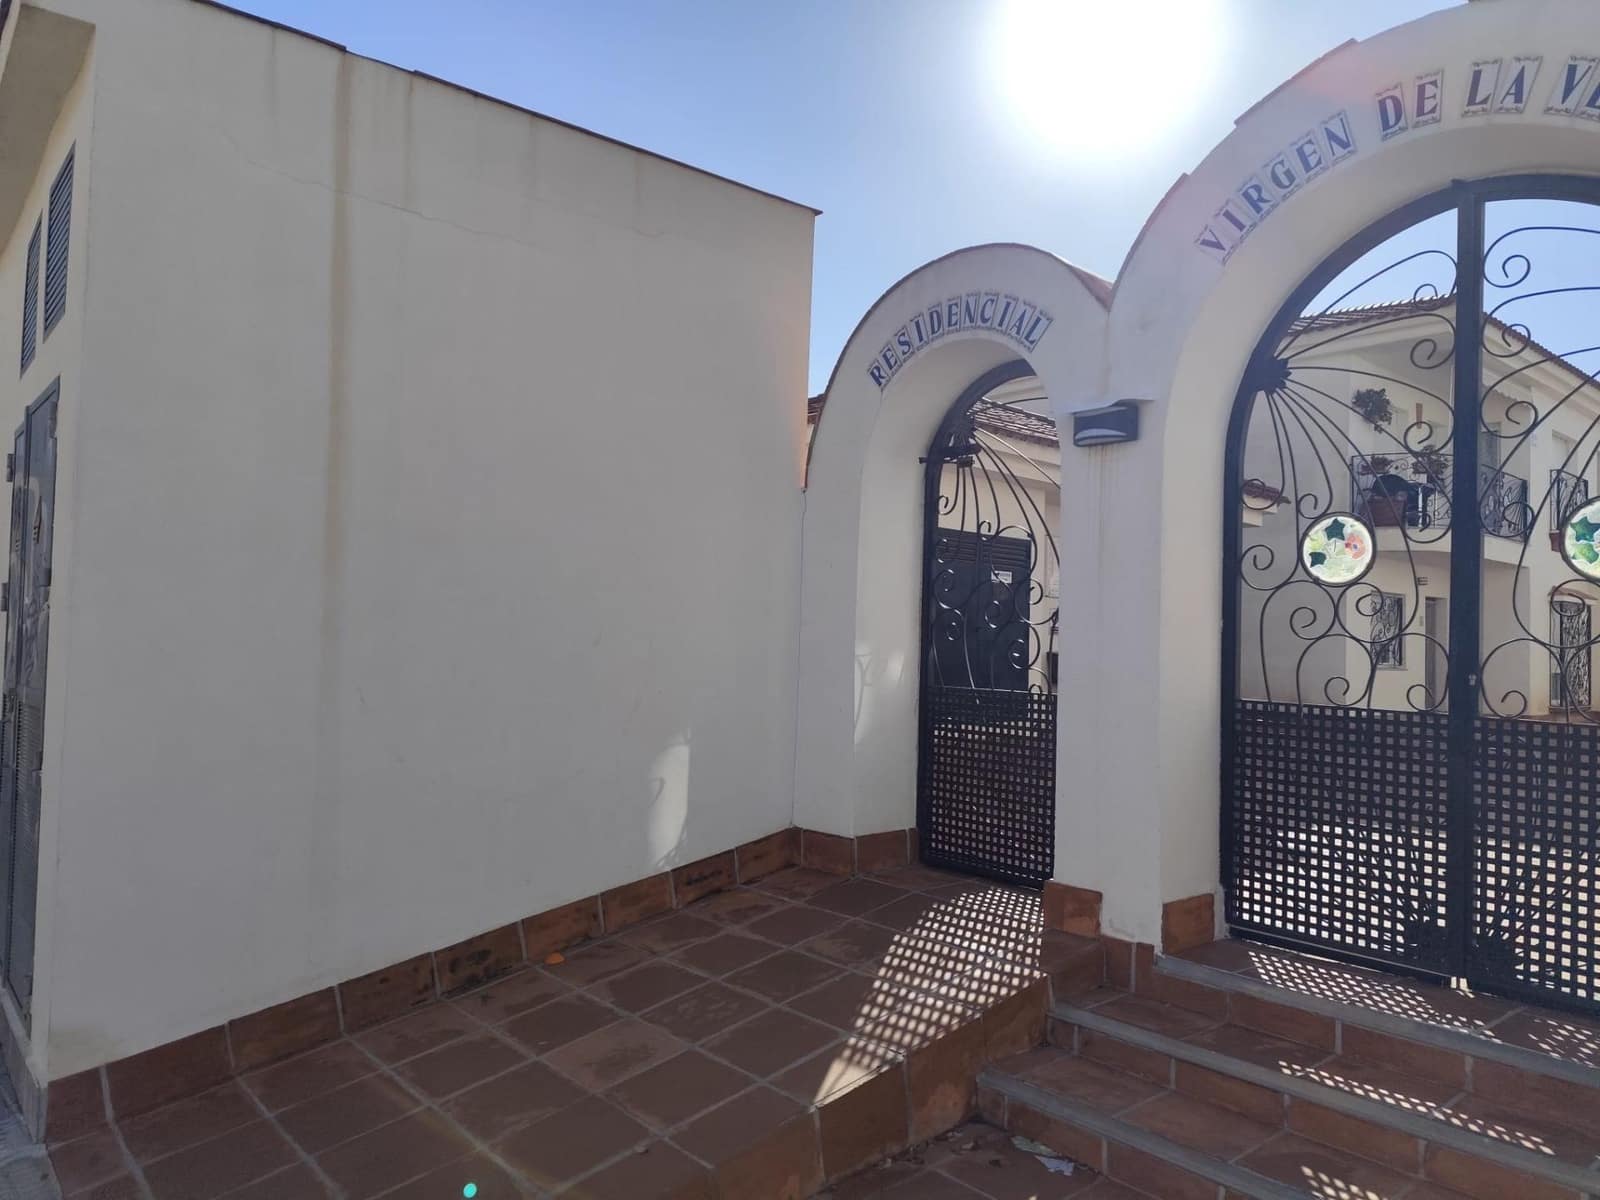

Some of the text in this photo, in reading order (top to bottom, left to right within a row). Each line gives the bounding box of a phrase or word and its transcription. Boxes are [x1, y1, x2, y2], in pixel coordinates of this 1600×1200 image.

[1199, 116, 1353, 253] VIRGEN
[1377, 79, 1440, 134] DE
[1465, 64, 1526, 107] LA
[869, 294, 1043, 388] RESIDENCIAL
